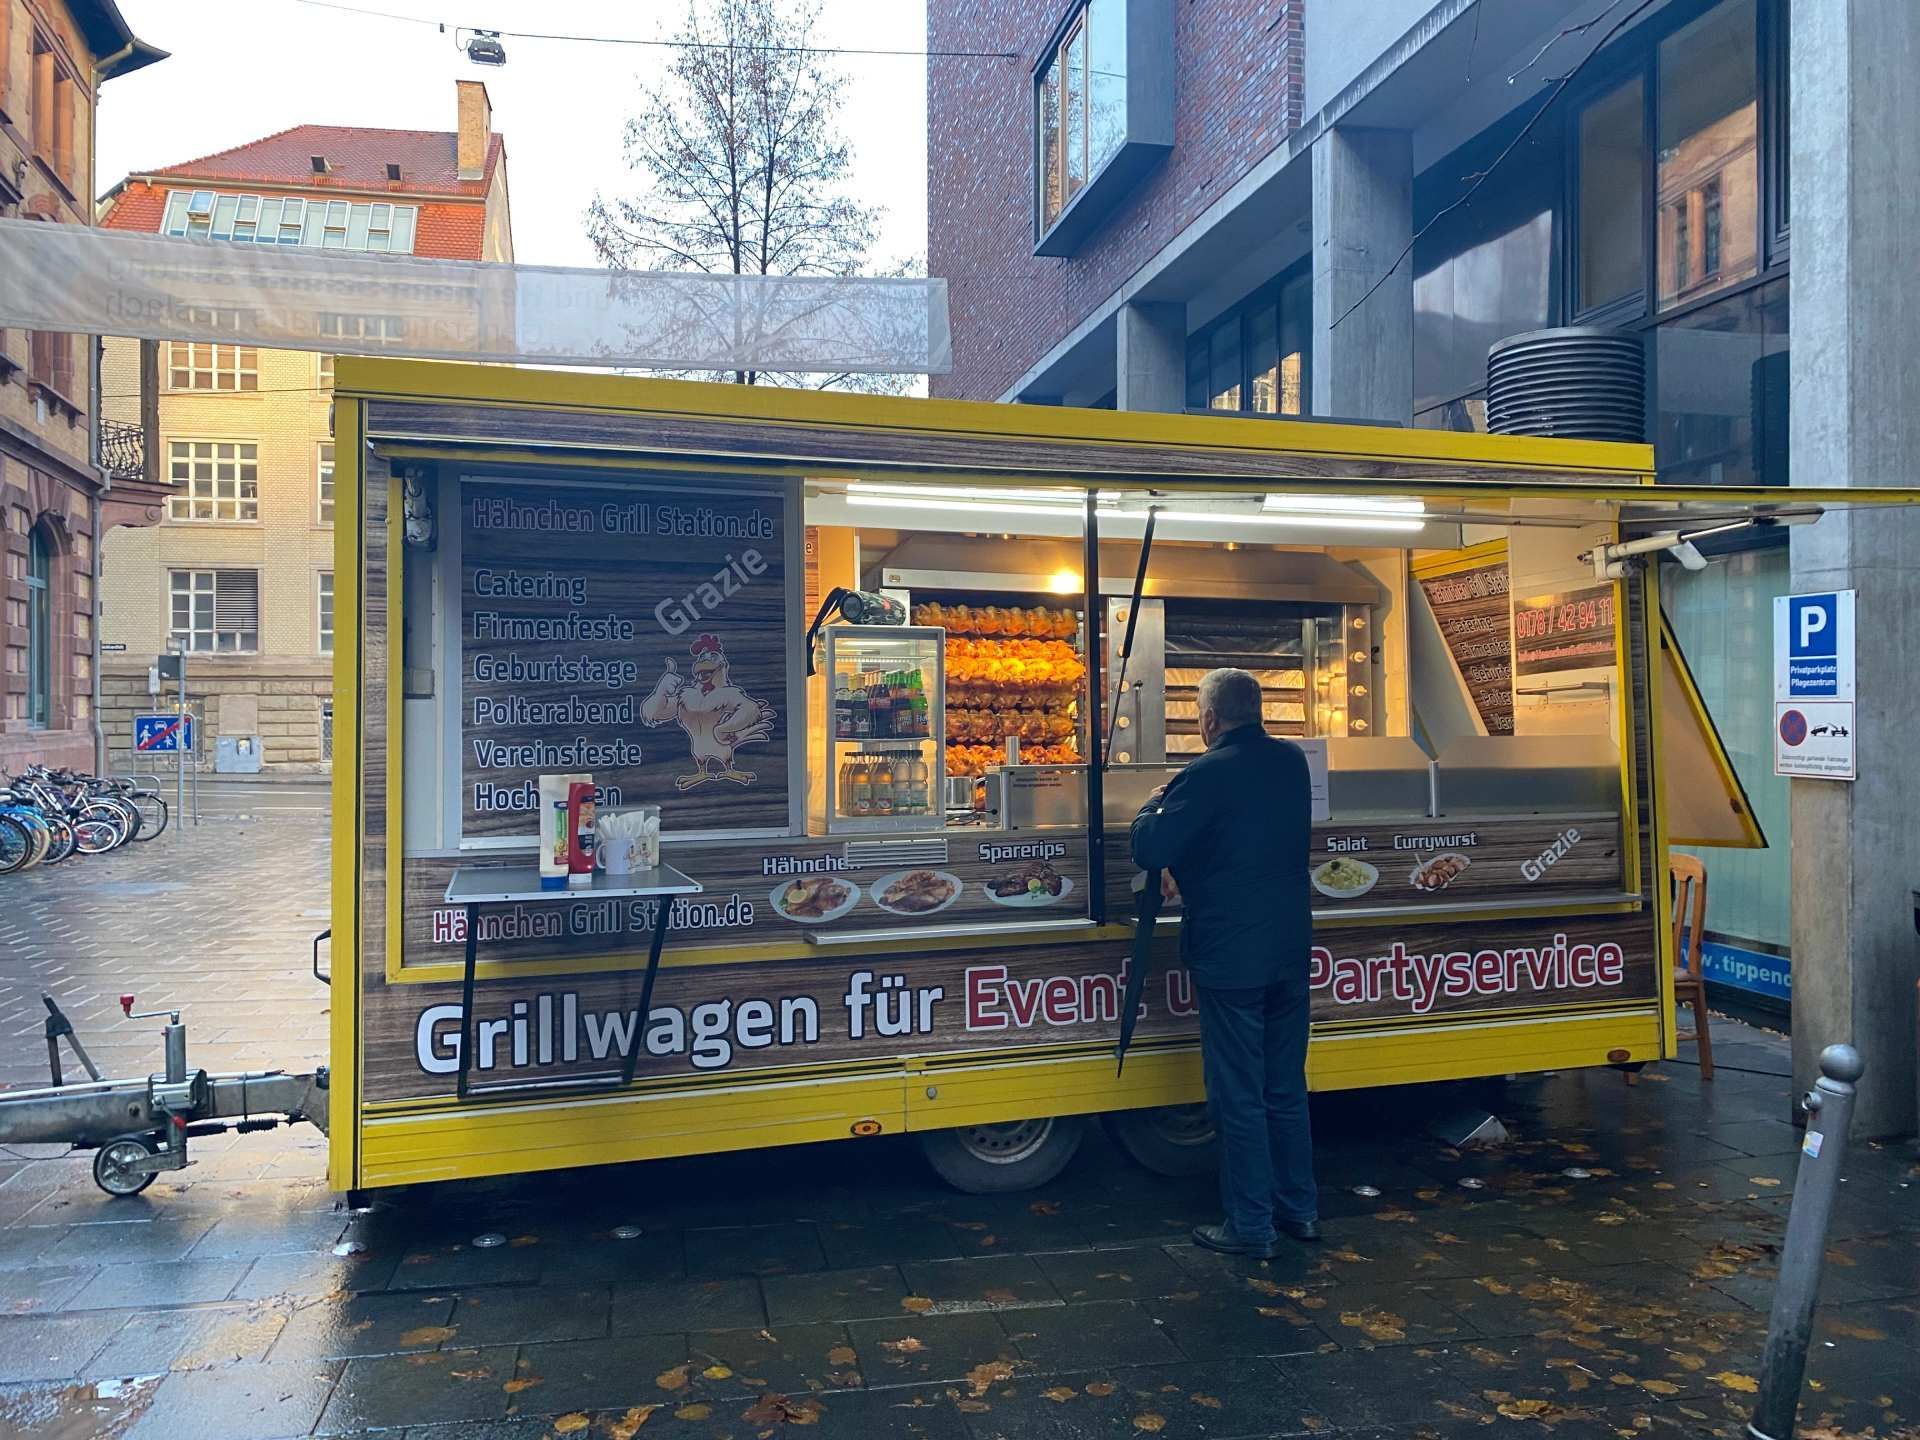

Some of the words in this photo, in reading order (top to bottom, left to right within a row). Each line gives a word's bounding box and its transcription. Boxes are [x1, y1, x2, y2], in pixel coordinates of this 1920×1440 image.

[473, 497, 594, 531] Hähnchen
[602, 504, 650, 533] Grill
[656, 506, 775, 539] Station.de
[474, 569, 587, 606] Catering
[654, 549, 769, 635] Grazie
[474, 611, 635, 641] Firmenfeste
[1449, 615, 1496, 637] Catering
[1517, 608, 1547, 638] 0178
[1548, 605, 1556, 634] /
[1558, 603, 1576, 631] 42
[1579, 600, 1597, 629] 94
[1800, 605, 1827, 648] P
[474, 653, 637, 689] Geburtstage
[474, 695, 634, 725] Polterabend
[474, 737, 642, 768] Vereinsfeste
[1327, 836, 1369, 853] Salat
[1394, 831, 1478, 852] Currywurst
[1520, 826, 1582, 882] Grazie
[763, 854, 862, 876] Hähnche
[570, 901, 622, 937] Grill
[630, 894, 754, 935] Sttion.de
[416, 991, 820, 1075] Grillwagen
[844, 969, 945, 1041] für
